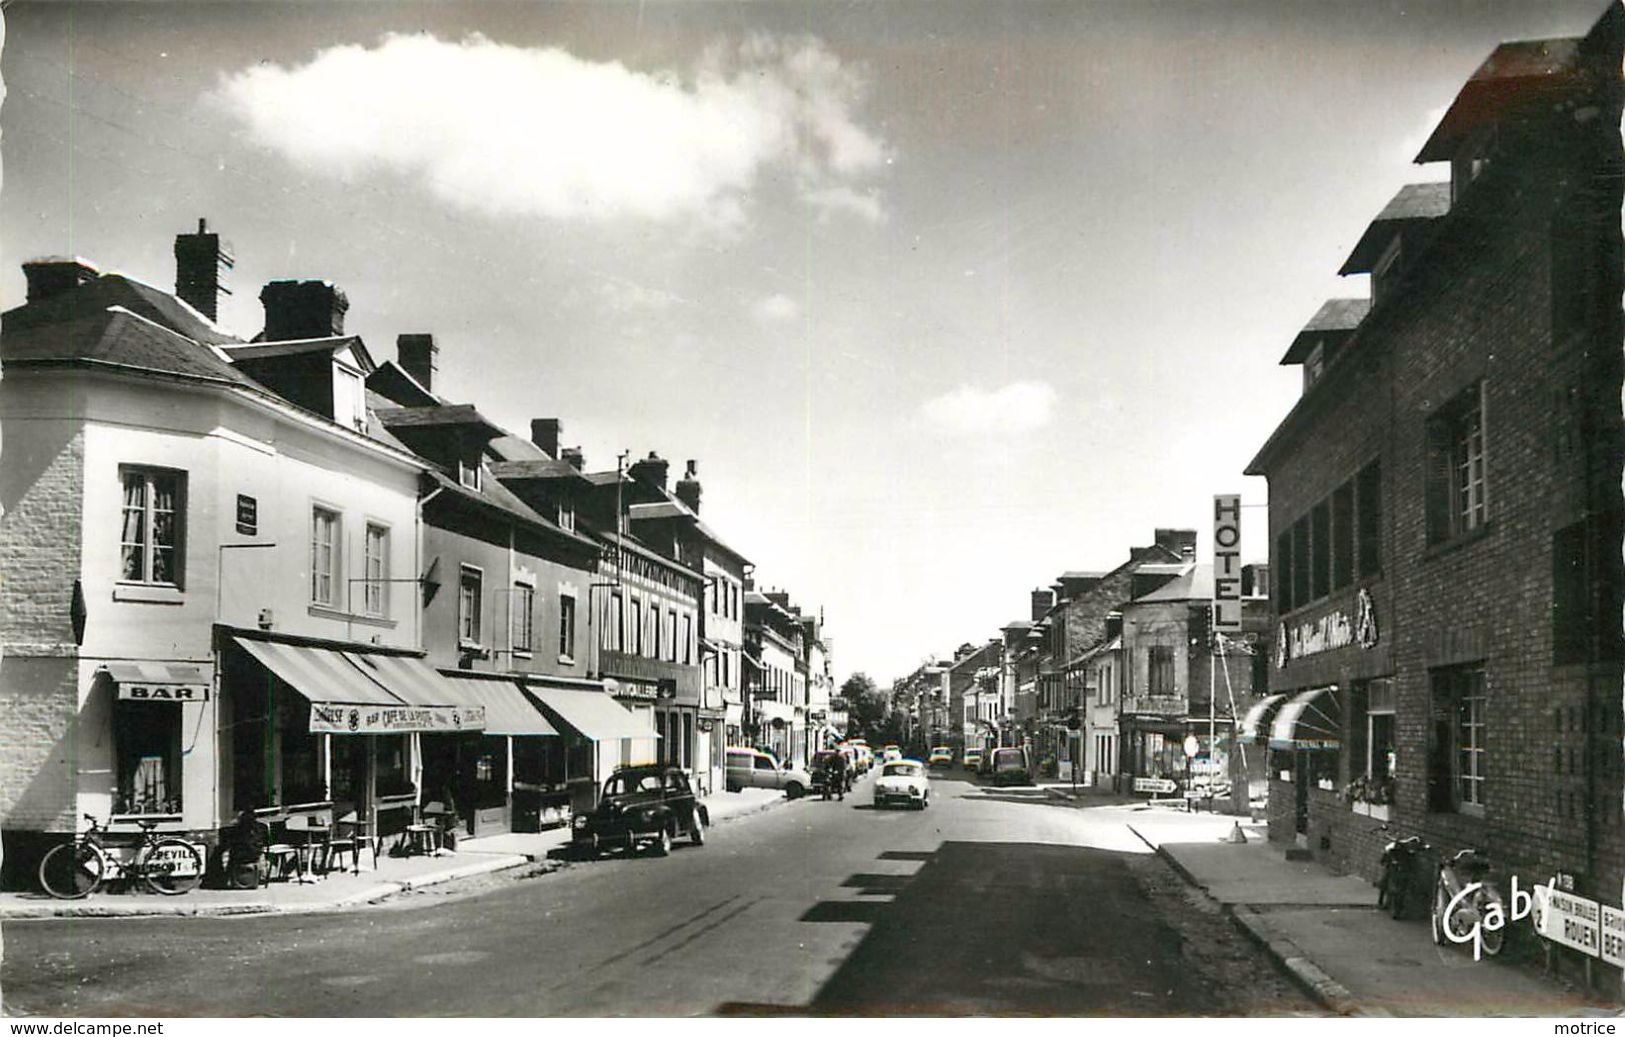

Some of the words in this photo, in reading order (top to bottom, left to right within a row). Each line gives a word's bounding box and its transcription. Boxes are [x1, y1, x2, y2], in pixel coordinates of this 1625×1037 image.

[1215, 498, 1240, 627] HOTEL
[130, 687, 193, 699] BAR
[365, 712, 379, 726] BAR
[1564, 918, 1598, 950] ROUEN
